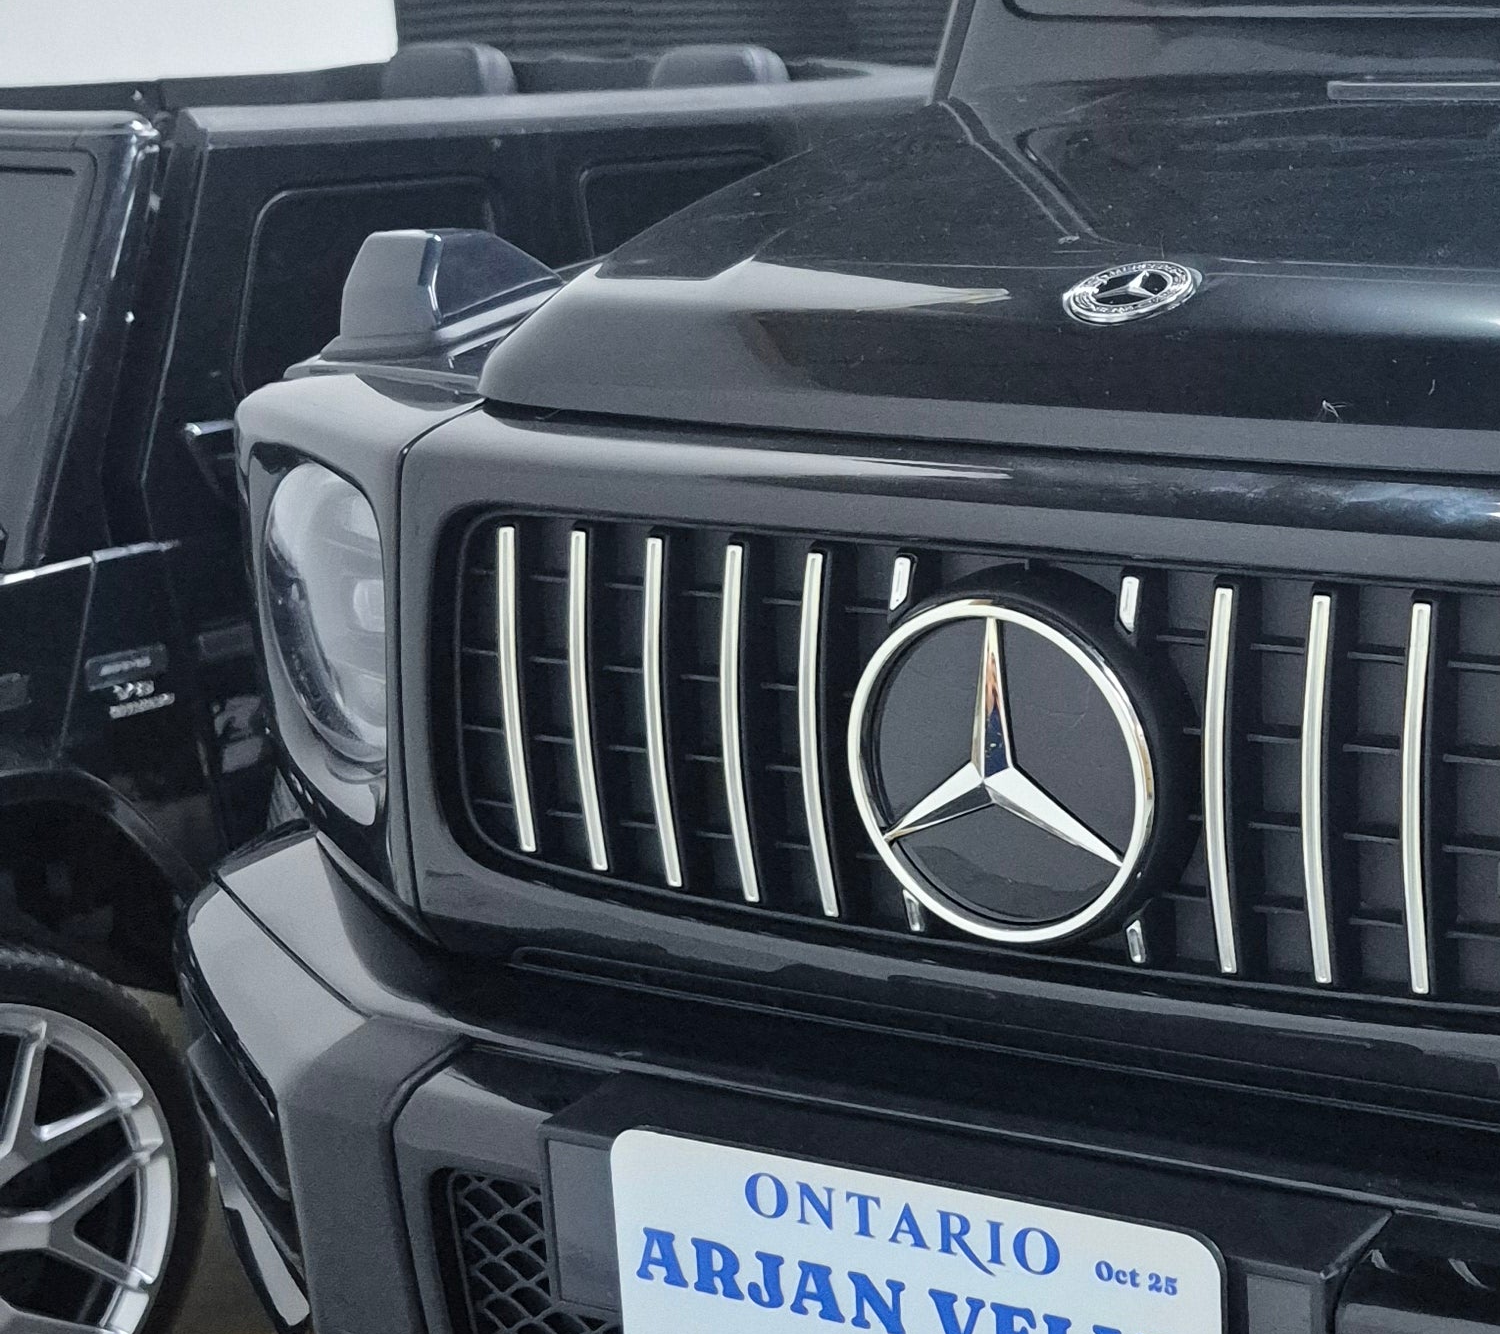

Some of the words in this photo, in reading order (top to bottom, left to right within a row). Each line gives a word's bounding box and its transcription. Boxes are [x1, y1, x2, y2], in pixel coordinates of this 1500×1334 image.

[743, 1171, 1061, 1276] ONTARIO
[1094, 1259, 1140, 1289] Oct
[1147, 1271, 1178, 1297] 25
